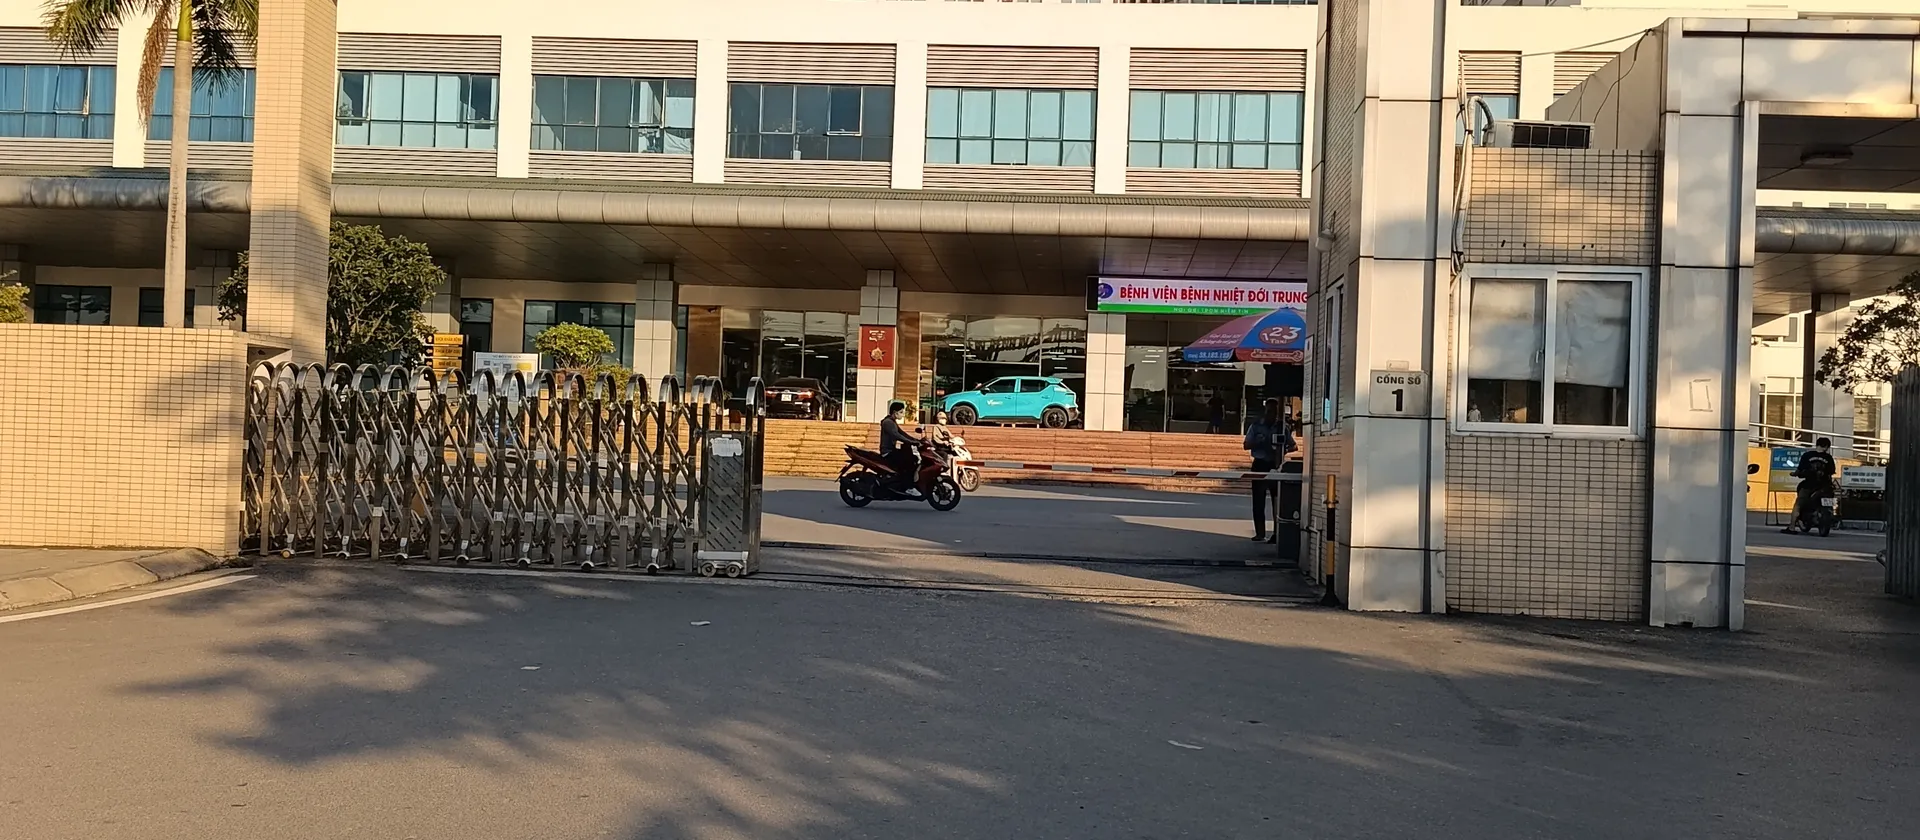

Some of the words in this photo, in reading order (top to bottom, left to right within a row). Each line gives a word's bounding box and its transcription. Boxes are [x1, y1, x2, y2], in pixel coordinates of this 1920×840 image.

[1120, 284, 1149, 302] BỆNH
[1153, 285, 1177, 303] VIỆN
[1181, 286, 1210, 304] BỆNH
[1213, 287, 1245, 305] NHIỆT
[1248, 287, 1269, 302] ĐỚI
[1407, 374, 1422, 385] SỐ
[1391, 388, 1403, 411] 1
